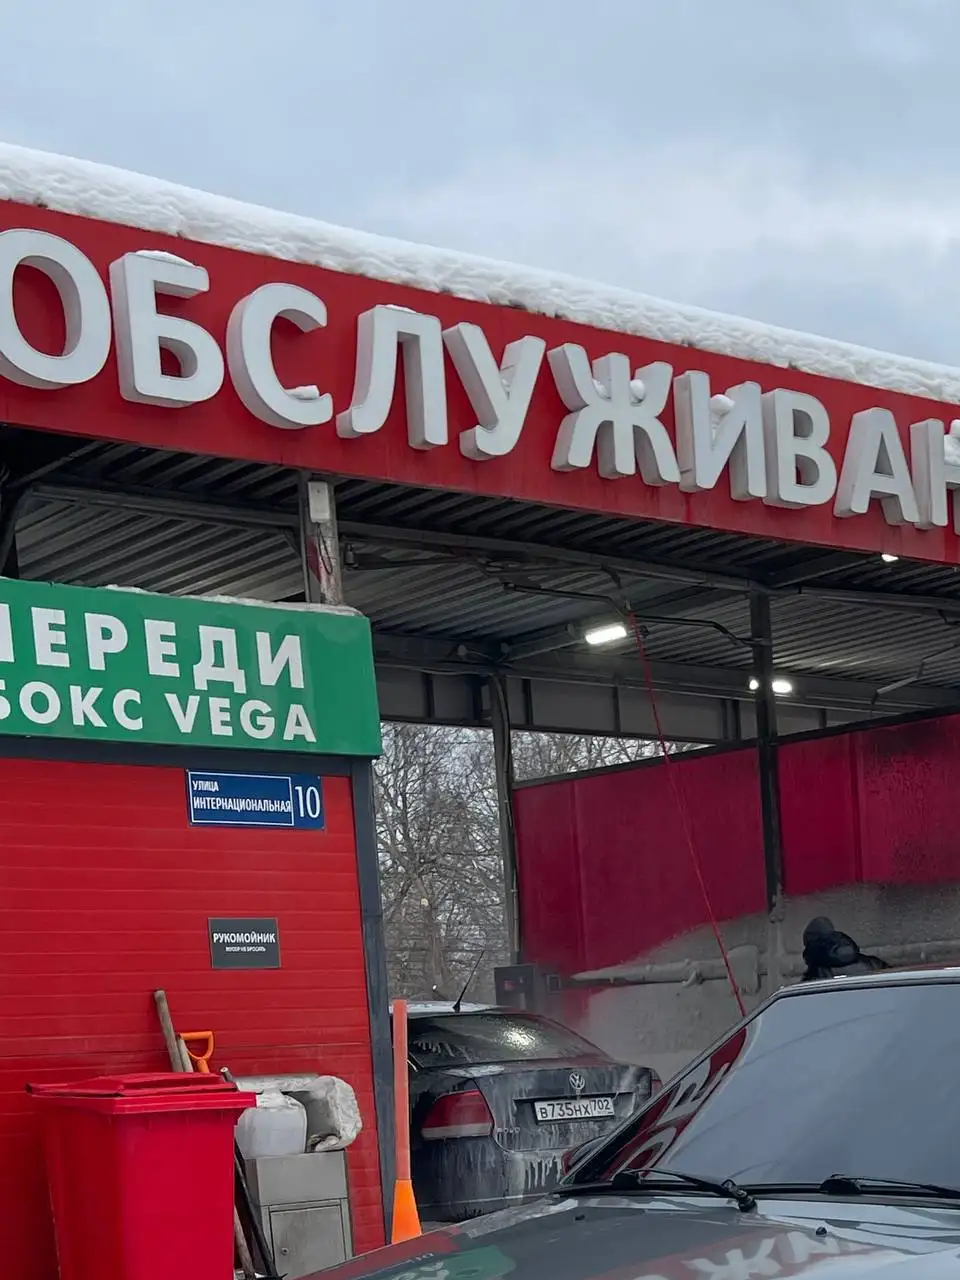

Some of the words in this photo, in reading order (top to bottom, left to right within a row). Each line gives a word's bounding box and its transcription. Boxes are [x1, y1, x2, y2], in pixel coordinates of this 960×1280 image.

[165, 693, 317, 743] VEGA
[192, 780, 219, 792] УЛИЦА
[193, 797, 291, 812] ИНТЕРНАЦИОНАЛЬНАЯ
[295, 786, 320, 818] 10
[213, 931, 276, 943] РУКОМОЙНИК
